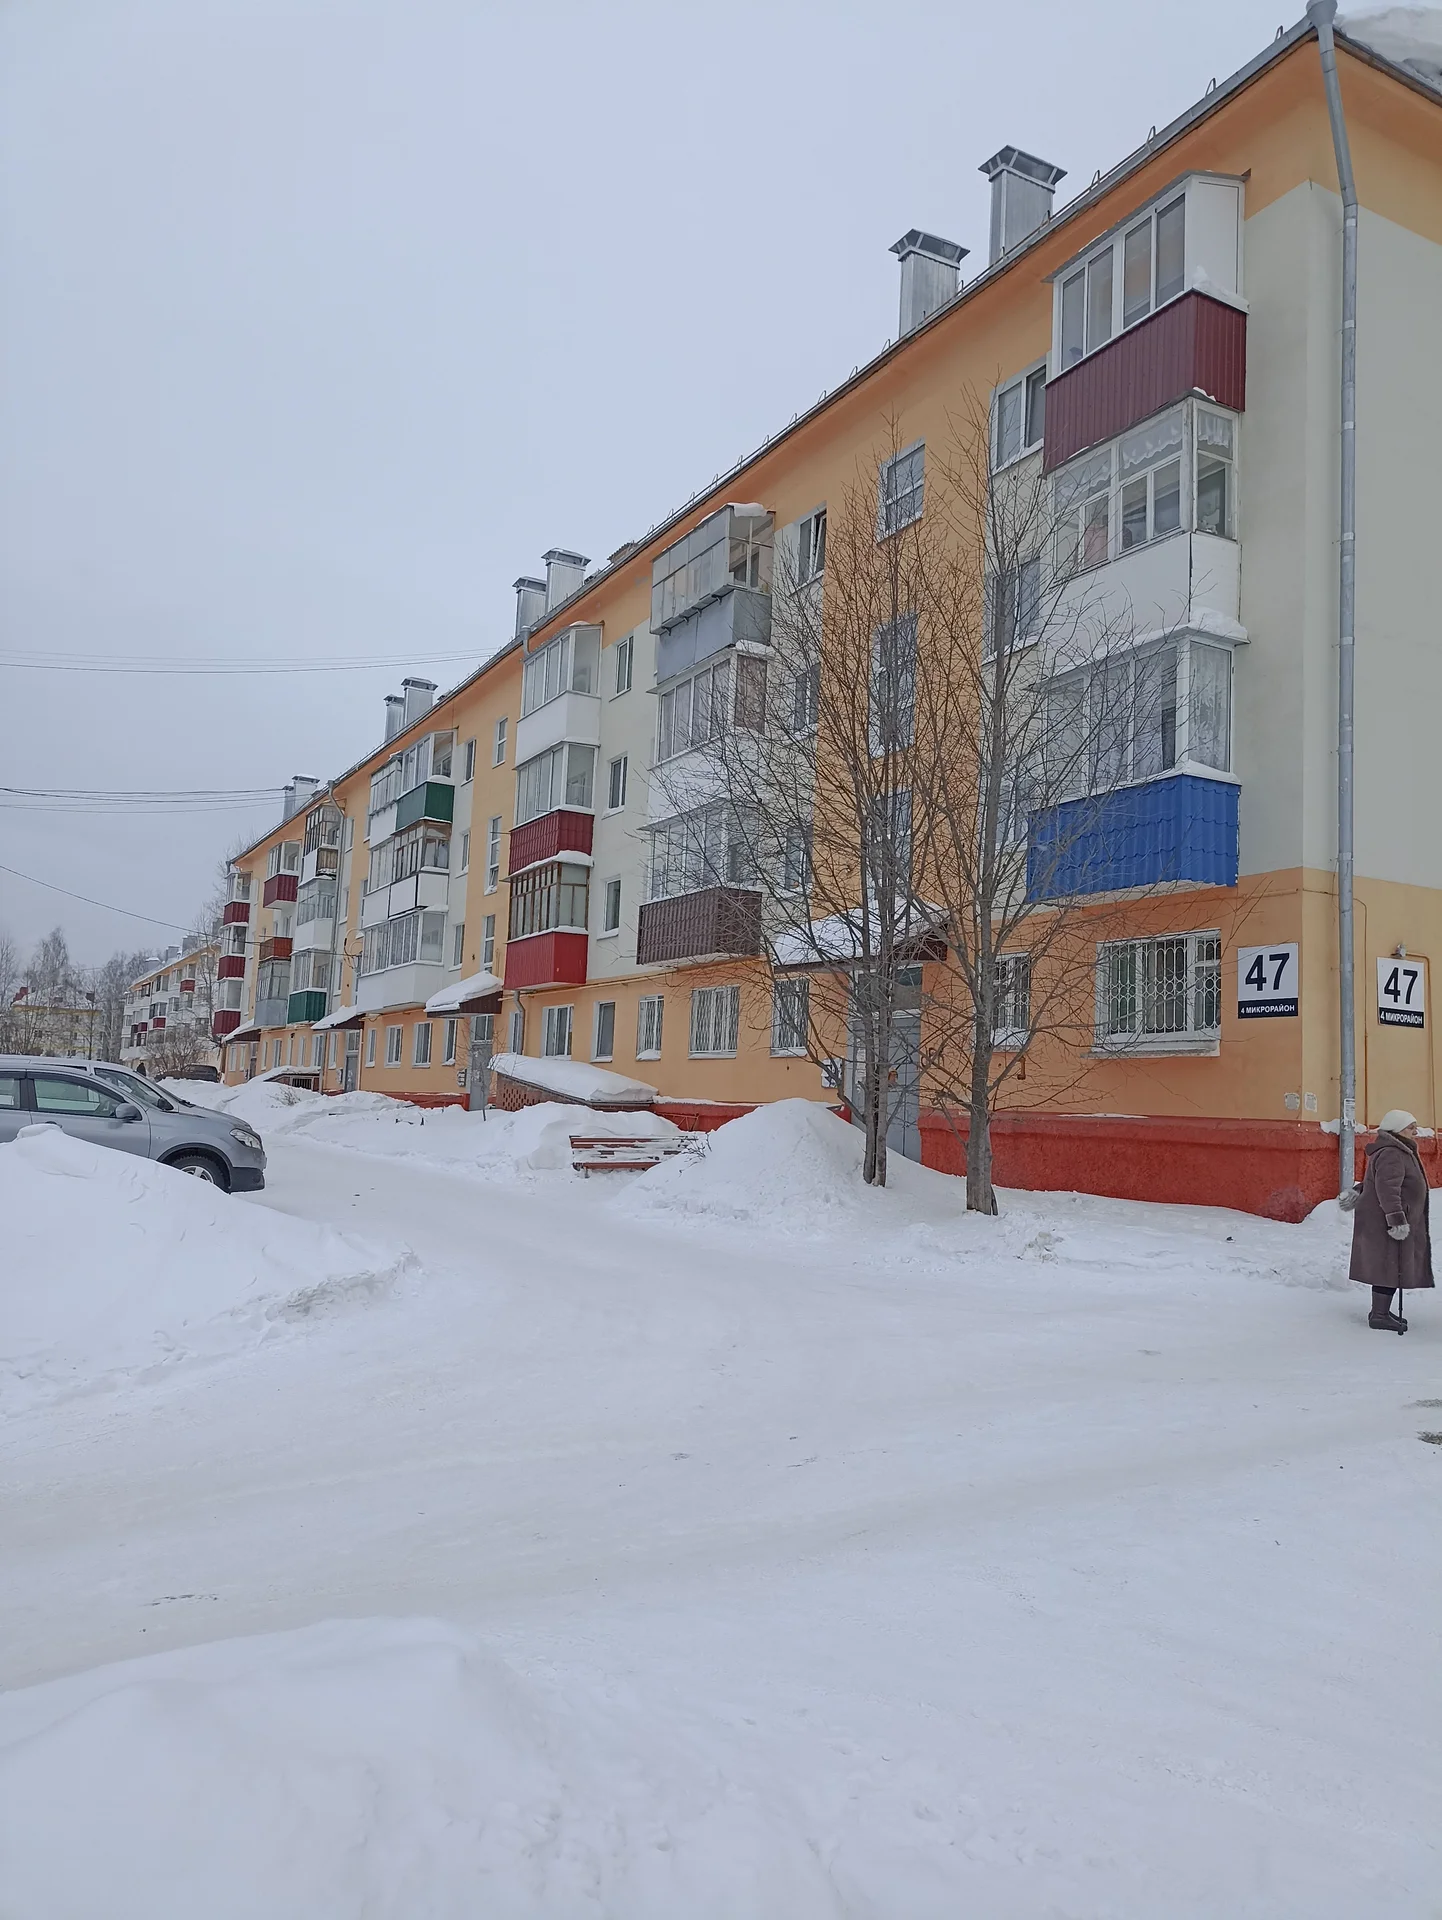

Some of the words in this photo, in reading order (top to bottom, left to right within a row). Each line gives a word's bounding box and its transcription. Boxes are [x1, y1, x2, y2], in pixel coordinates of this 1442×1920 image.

[1245, 953, 1290, 991] 47
[1384, 967, 1418, 1004] 47
[1246, 1004, 1295, 1013] МИКРОРАЙОН
[1380, 1011, 1385, 1020] 4
[1385, 1013, 1422, 1024] МИКРОРАЙОН
